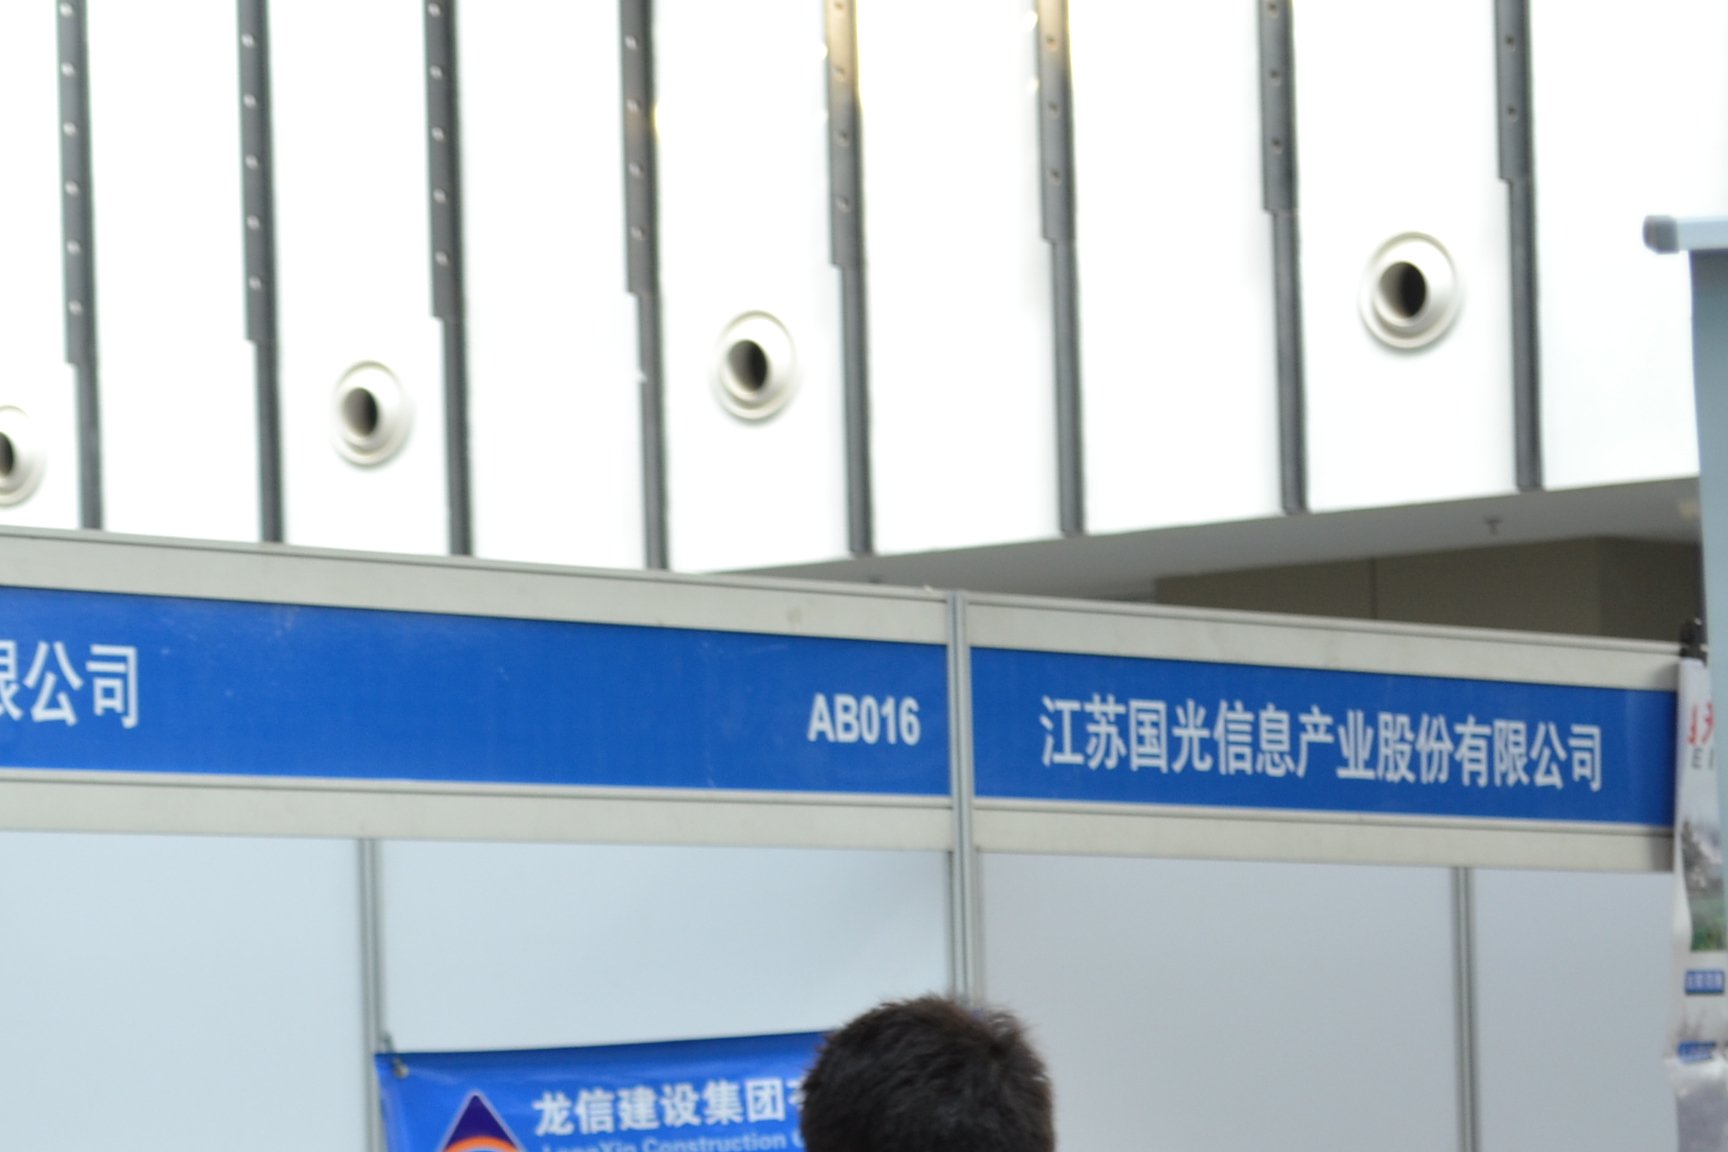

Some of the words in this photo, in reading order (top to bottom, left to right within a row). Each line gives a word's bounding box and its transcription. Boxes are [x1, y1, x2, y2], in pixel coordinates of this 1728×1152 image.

[807, 692, 921, 747] AB016
[1039, 693, 1603, 791] 江苏国光信息产业股份有限公司
